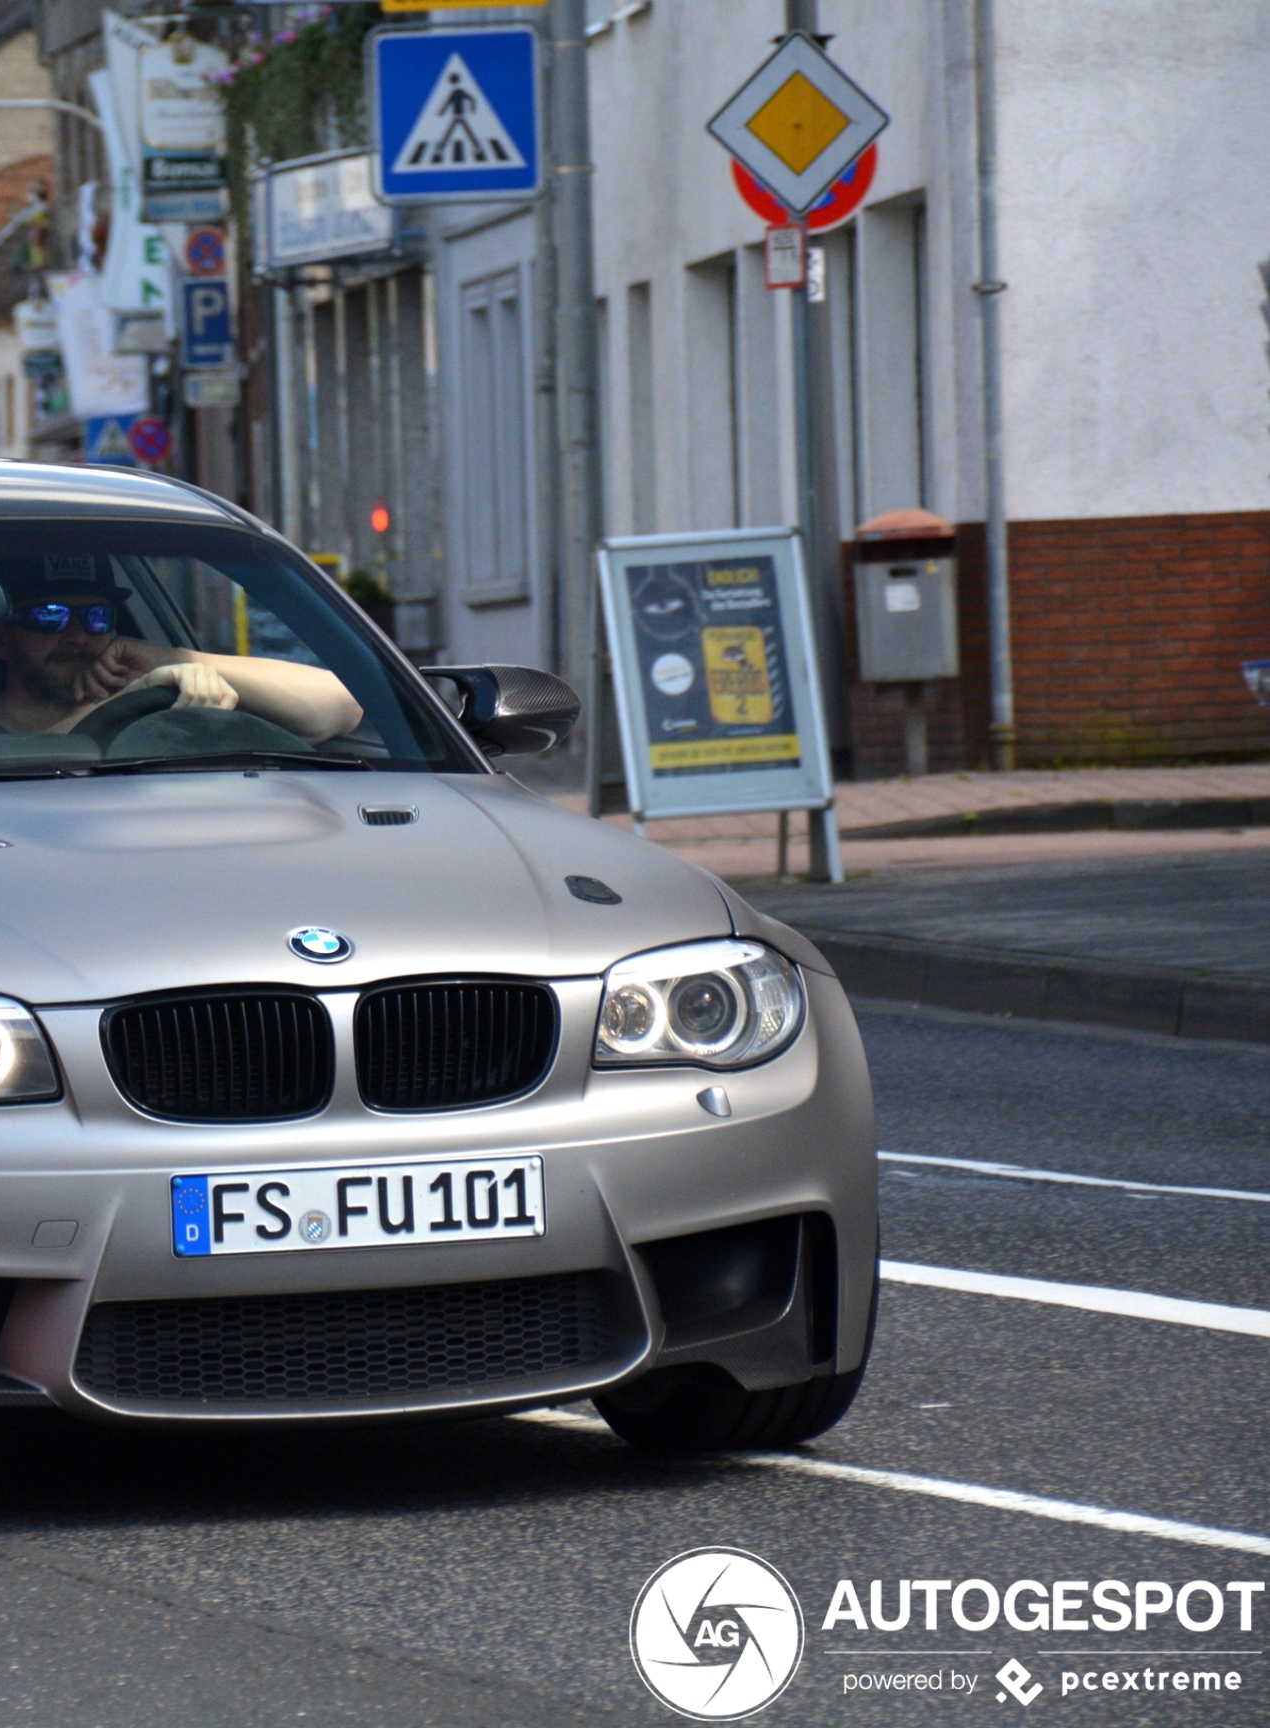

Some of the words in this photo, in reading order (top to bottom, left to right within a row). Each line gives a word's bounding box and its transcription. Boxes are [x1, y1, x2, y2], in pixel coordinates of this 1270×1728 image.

[192, 286, 225, 336] P
[212, 1181, 292, 1244] FS
[336, 1174, 415, 1237] FU
[429, 1167, 536, 1232] 101
[186, 1223, 200, 1242] D
